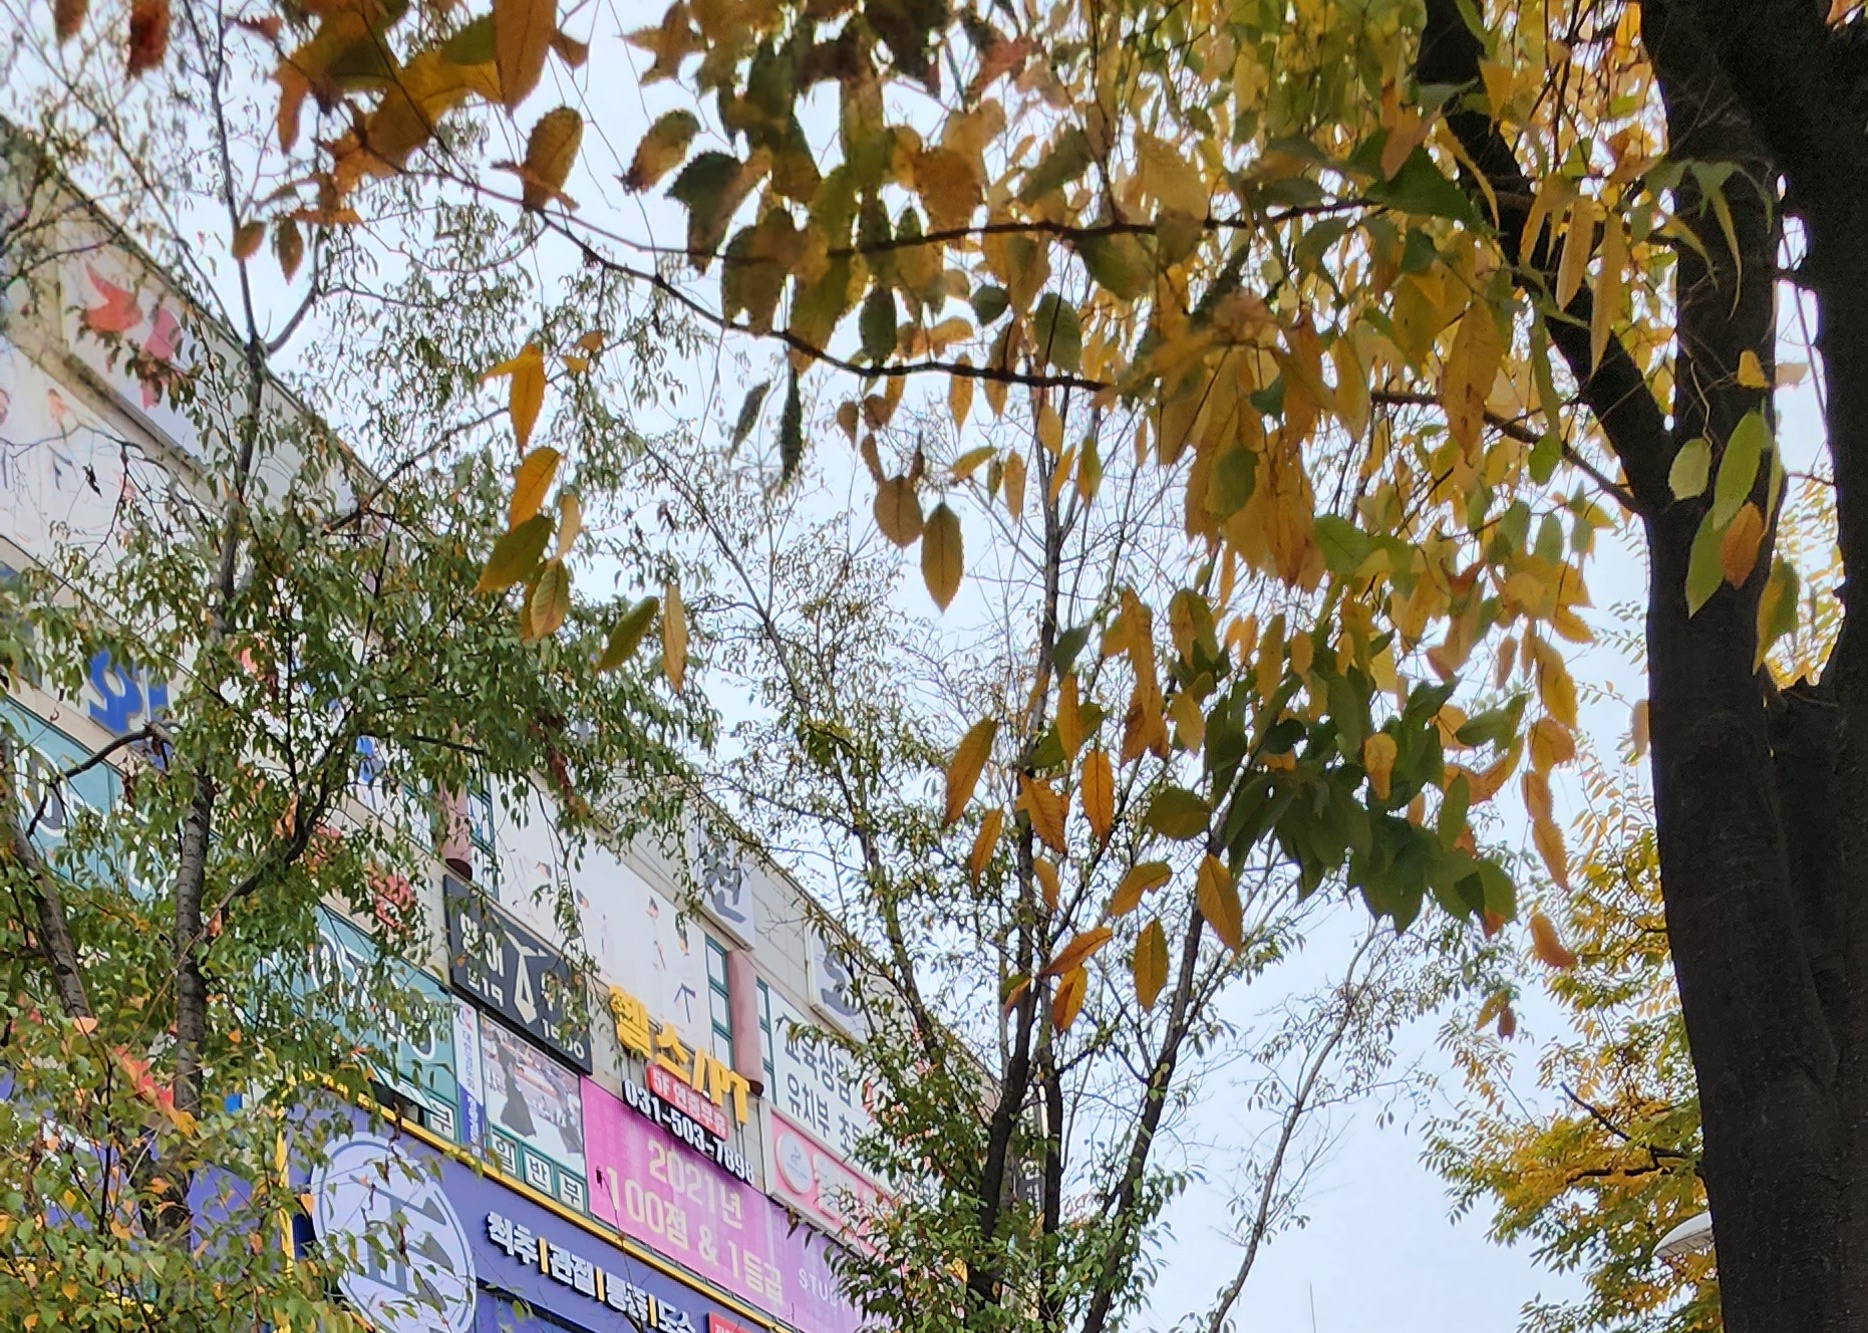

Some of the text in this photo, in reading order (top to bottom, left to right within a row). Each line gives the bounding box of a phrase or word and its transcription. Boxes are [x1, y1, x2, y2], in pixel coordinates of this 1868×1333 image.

[624, 1080, 756, 1184] 031-503-7898
[787, 1072, 831, 1138] 유치부
[647, 1139, 743, 1231] 2021년
[606, 1166, 690, 1251] 100점
[728, 1239, 785, 1306] 1등급
